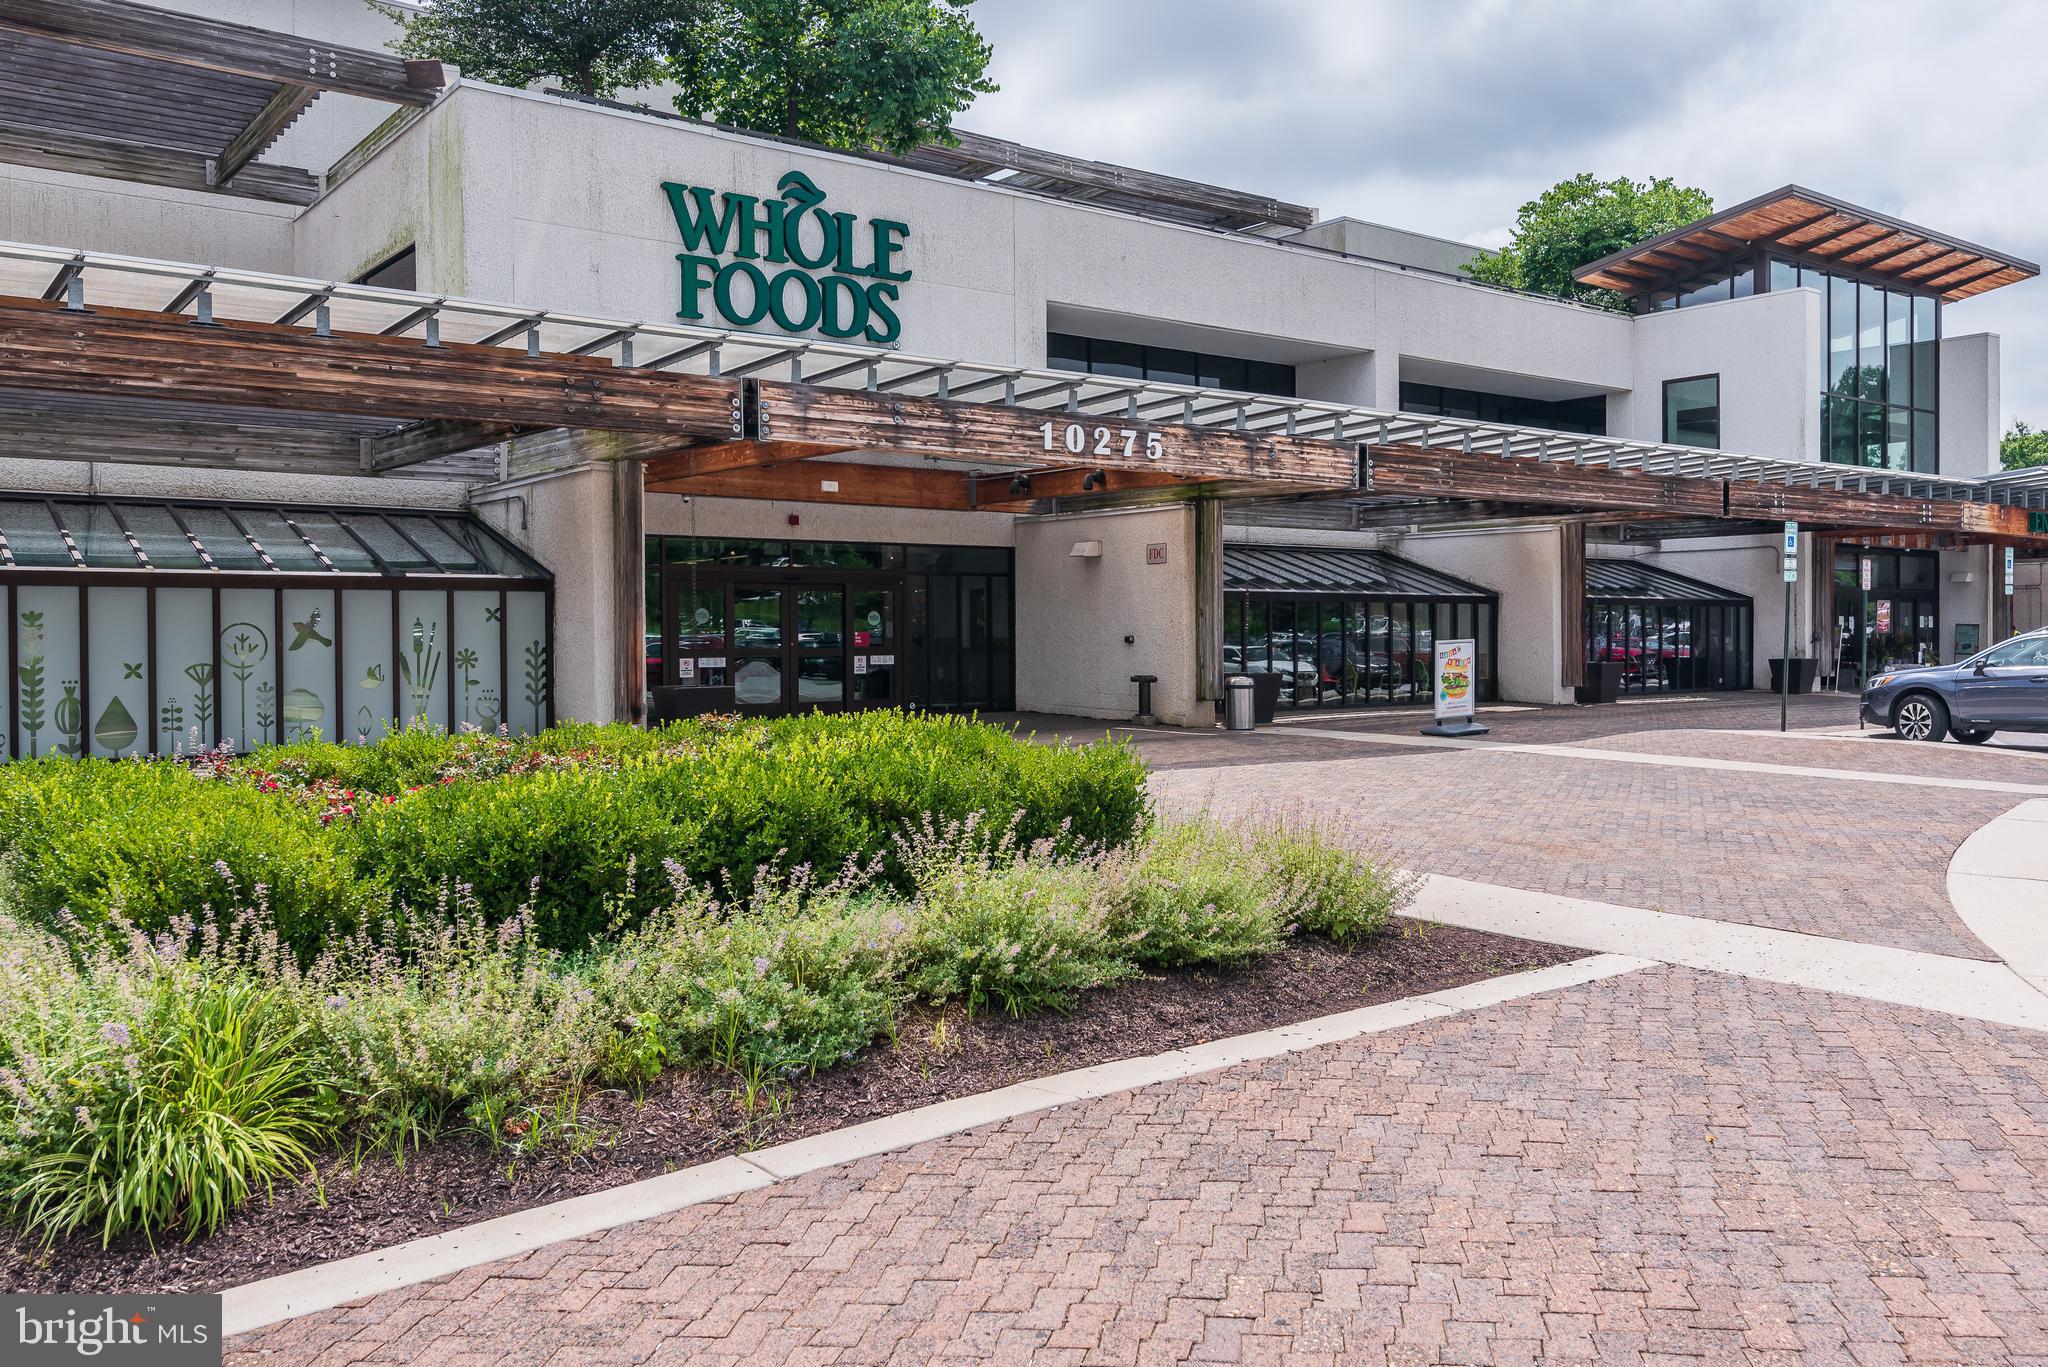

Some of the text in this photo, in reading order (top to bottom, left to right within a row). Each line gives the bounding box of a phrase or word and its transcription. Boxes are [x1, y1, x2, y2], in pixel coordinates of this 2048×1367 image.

[660, 178, 912, 282] WHOLE
[675, 253, 901, 343] FOODS
[1040, 422, 1163, 460] 10275
[1149, 547, 1164, 560] FDC
